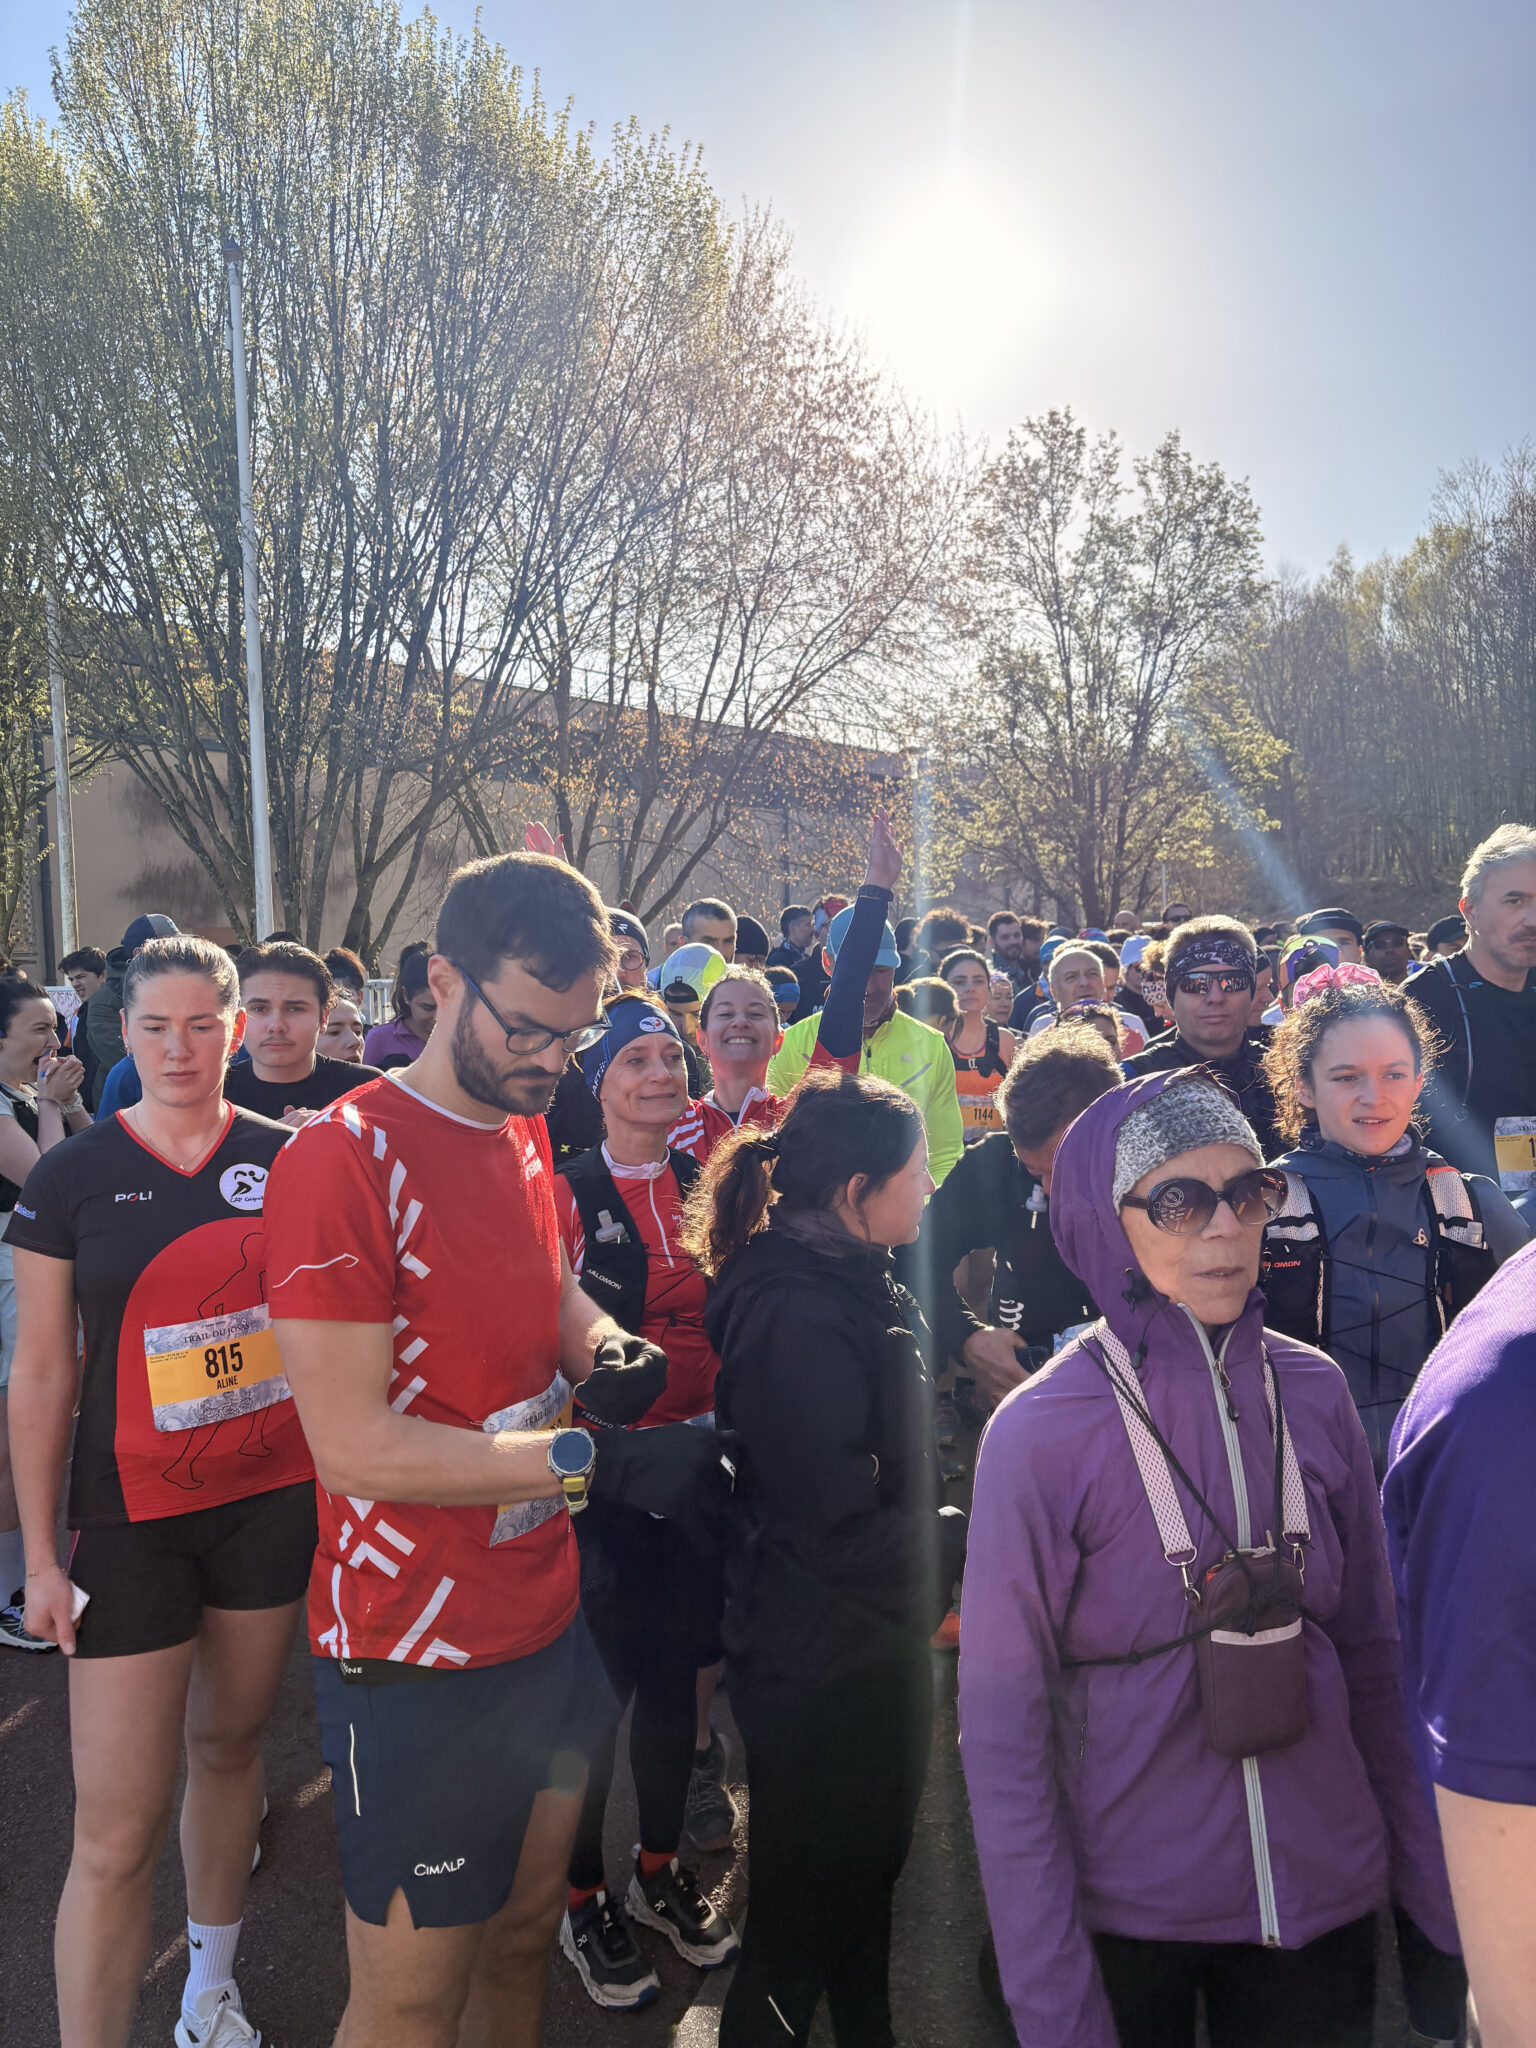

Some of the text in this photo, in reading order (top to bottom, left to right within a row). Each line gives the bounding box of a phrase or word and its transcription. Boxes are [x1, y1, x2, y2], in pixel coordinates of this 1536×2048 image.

[974, 1108, 993, 1120] 1144
[114, 1191, 152, 1203] POLI
[586, 1268, 622, 1290] SALOMON
[184, 1331, 210, 1344] TRAIL
[212, 1328, 226, 1338] DU
[227, 1322, 250, 1337] JOSAS
[204, 1342, 243, 1378] 815
[216, 1375, 238, 1390] ALINE
